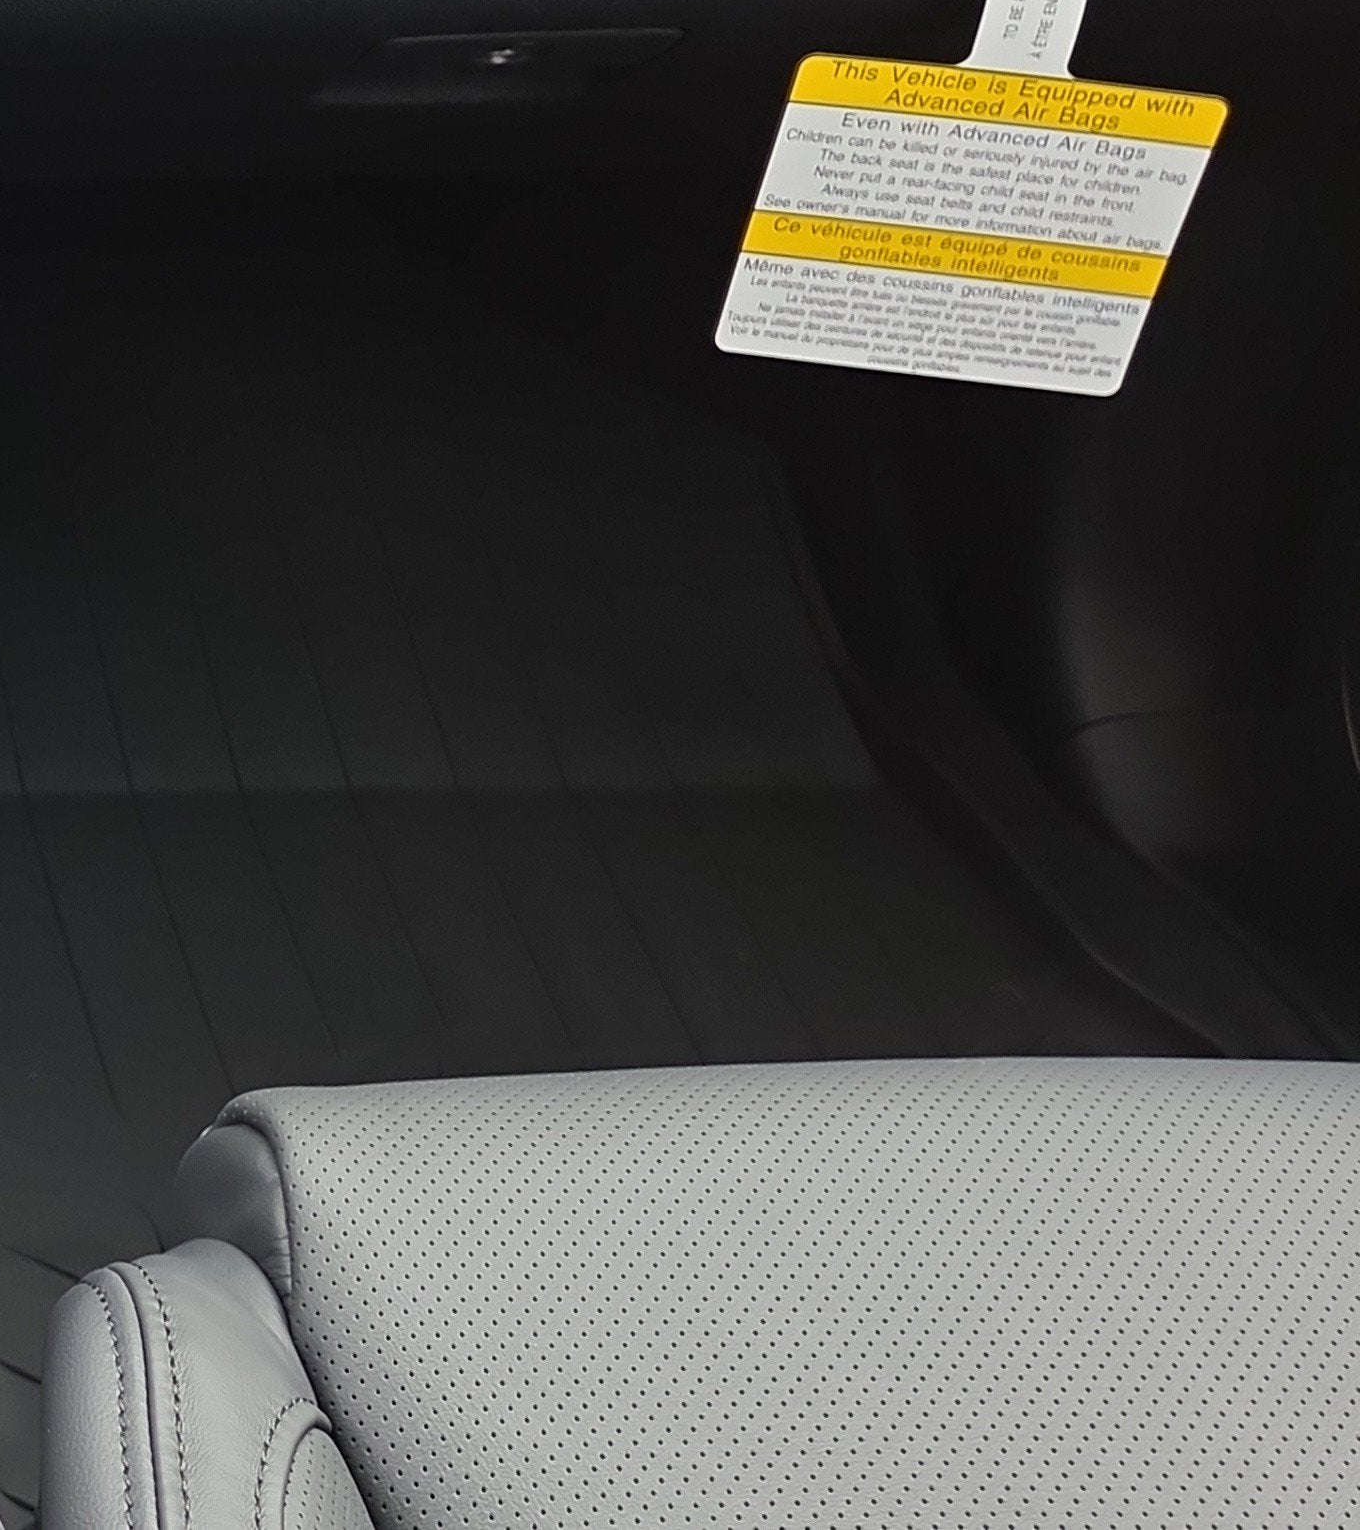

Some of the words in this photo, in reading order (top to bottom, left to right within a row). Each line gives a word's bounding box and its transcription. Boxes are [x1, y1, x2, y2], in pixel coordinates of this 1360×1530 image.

[832, 60, 879, 82] This
[893, 66, 976, 92] Vehicle
[988, 76, 1007, 95] is
[1020, 79, 1135, 110] Equipped
[1147, 96, 1194, 118] with
[885, 88, 1005, 117] Advanced
[1013, 102, 1049, 122] Air
[1059, 106, 1120, 131] Bags
[787, 128, 842, 144] Children
[848, 135, 873, 147] can
[881, 139, 896, 151] be
[904, 140, 938, 156] killed
[944, 147, 958, 157] or
[1031, 153, 1079, 170] injured
[1084, 159, 1105, 175] by
[1108, 162, 1129, 176] the
[1135, 168, 1153, 180] air
[841, 112, 890, 132] Even
[901, 120, 939, 136] with
[948, 124, 1050, 149] Advanced
[1057, 136, 1086, 153] Air
[1096, 140, 1147, 162] Bags
[814, 165, 854, 180] Never
[860, 172, 882, 185] put
[887, 176, 895, 185] a
[980, 183, 1014, 199] child
[1019, 189, 1049, 203] seat
[1054, 193, 1067, 204] in
[1073, 194, 1095, 207] the
[821, 148, 845, 162] The
[851, 151, 882, 166] back
[890, 157, 919, 170] seat
[924, 161, 935, 171] is
[942, 162, 963, 175] the
[1016, 170, 1054, 184] place
[1061, 175, 1079, 188] for
[764, 193, 791, 208] See
[855, 205, 906, 220] manual
[912, 209, 929, 223] for
[935, 214, 970, 227] more
[976, 219, 1052, 236] information
[1058, 228, 1098, 243] about
[1103, 233, 1122, 245] air
[821, 184, 869, 200] Always
[875, 191, 900, 202] use
[906, 193, 935, 207] seat
[940, 196, 973, 211] belts
[980, 201, 1006, 215] and
[1011, 205, 1044, 220] child
[773, 217, 801, 234] Ce
[811, 221, 892, 244] véhicule
[901, 233, 932, 248] est
[941, 238, 1008, 257] équipé
[1018, 245, 1042, 262] de
[1051, 250, 1141, 273] coussins
[951, 256, 1060, 282] intelligents
[743, 257, 794, 275] Même
[801, 266, 840, 280] avec
[846, 270, 876, 285] des
[882, 275, 954, 293] coussins
[1052, 292, 1140, 316] intelligents
